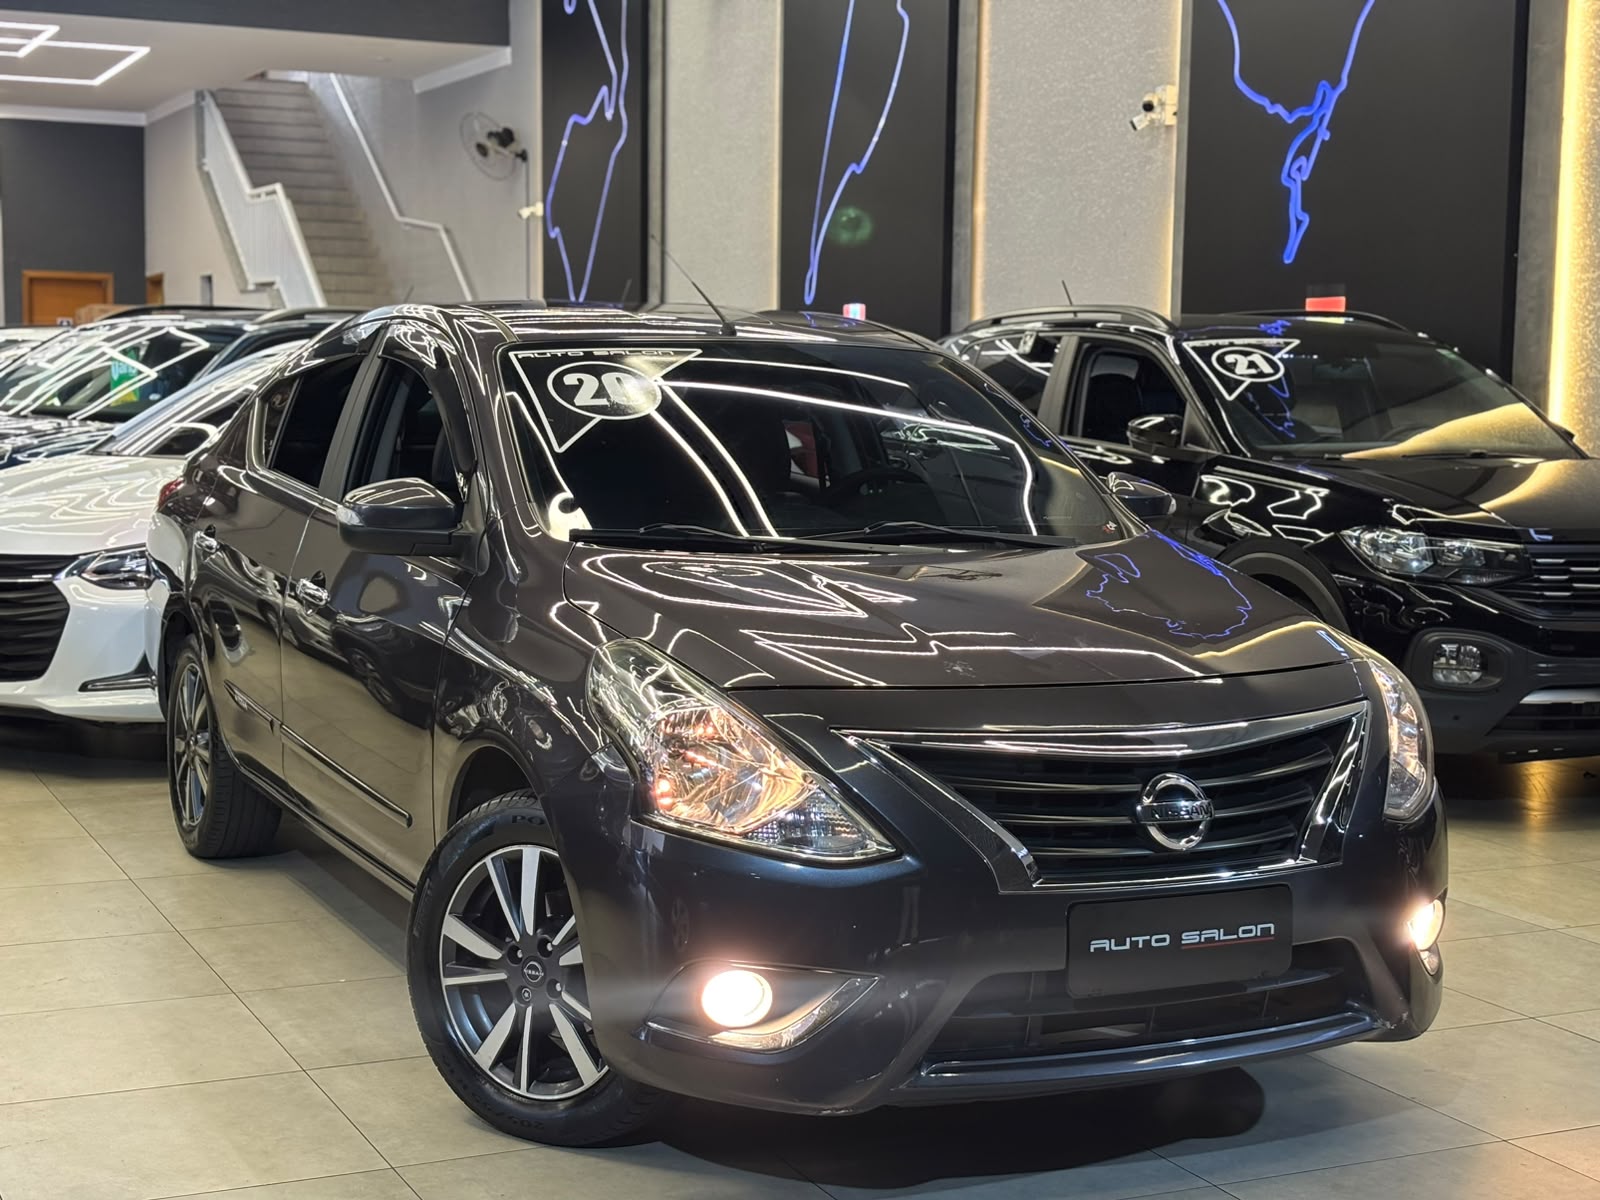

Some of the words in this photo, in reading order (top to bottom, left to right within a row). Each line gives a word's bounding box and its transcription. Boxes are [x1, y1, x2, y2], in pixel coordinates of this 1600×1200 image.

[518, 351, 584, 359] AUTO
[1224, 353, 1275, 375] 21
[563, 372, 646, 406] 20
[1090, 934, 1170, 953] AUTO
[1181, 923, 1275, 944] SALON
